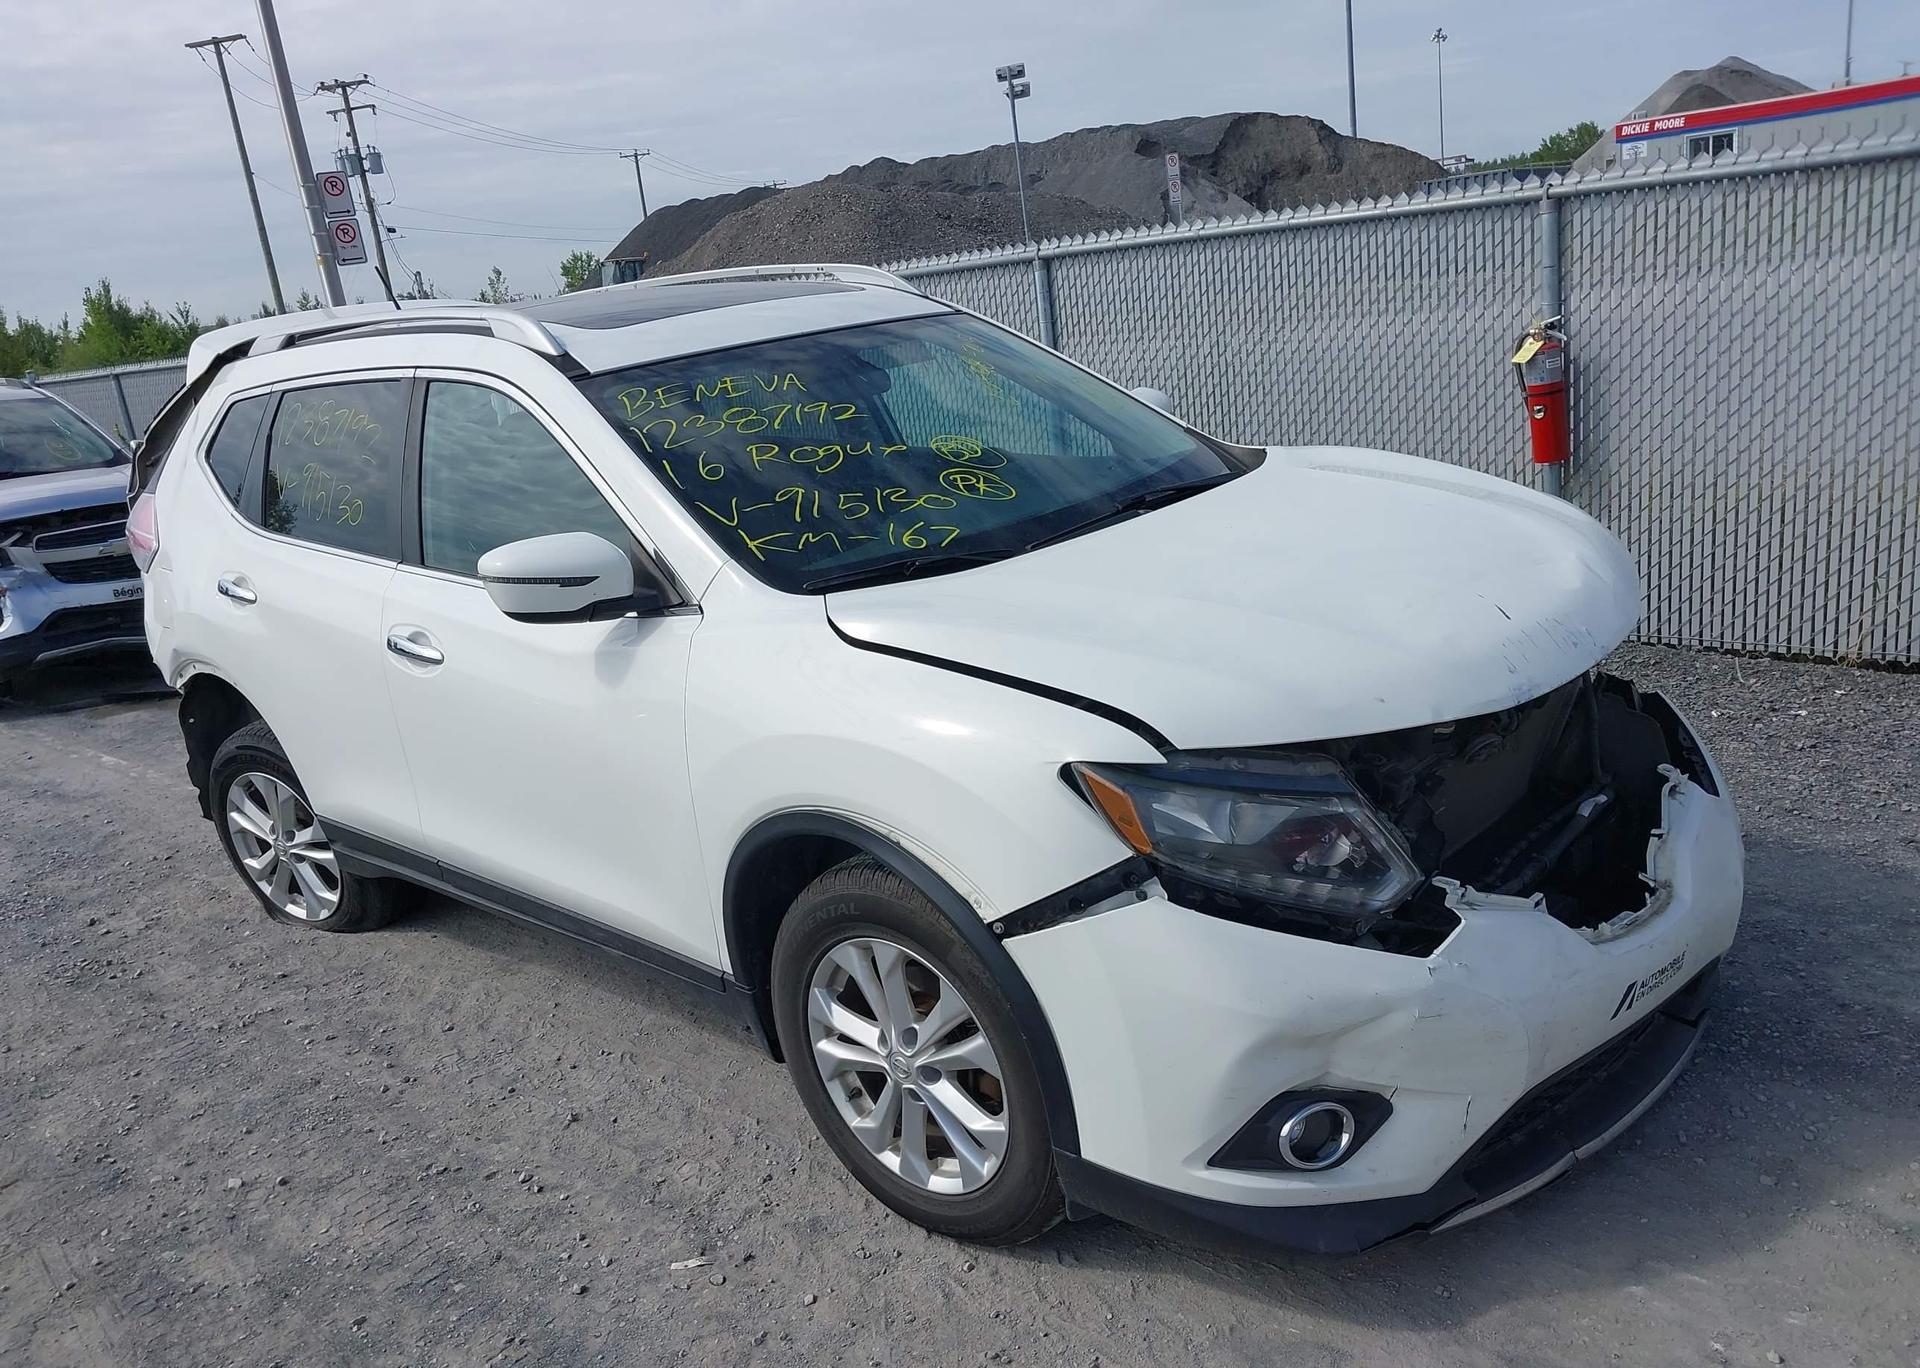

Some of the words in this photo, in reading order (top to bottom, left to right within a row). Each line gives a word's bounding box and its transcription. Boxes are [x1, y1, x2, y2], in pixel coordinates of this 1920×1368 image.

[1621, 122, 1651, 136] DICKIE
[1654, 117, 1686, 131] MOORE
[616, 372, 808, 422] BENEVA
[629, 401, 871, 454] 12387192
[113, 585, 142, 598] Bégin
